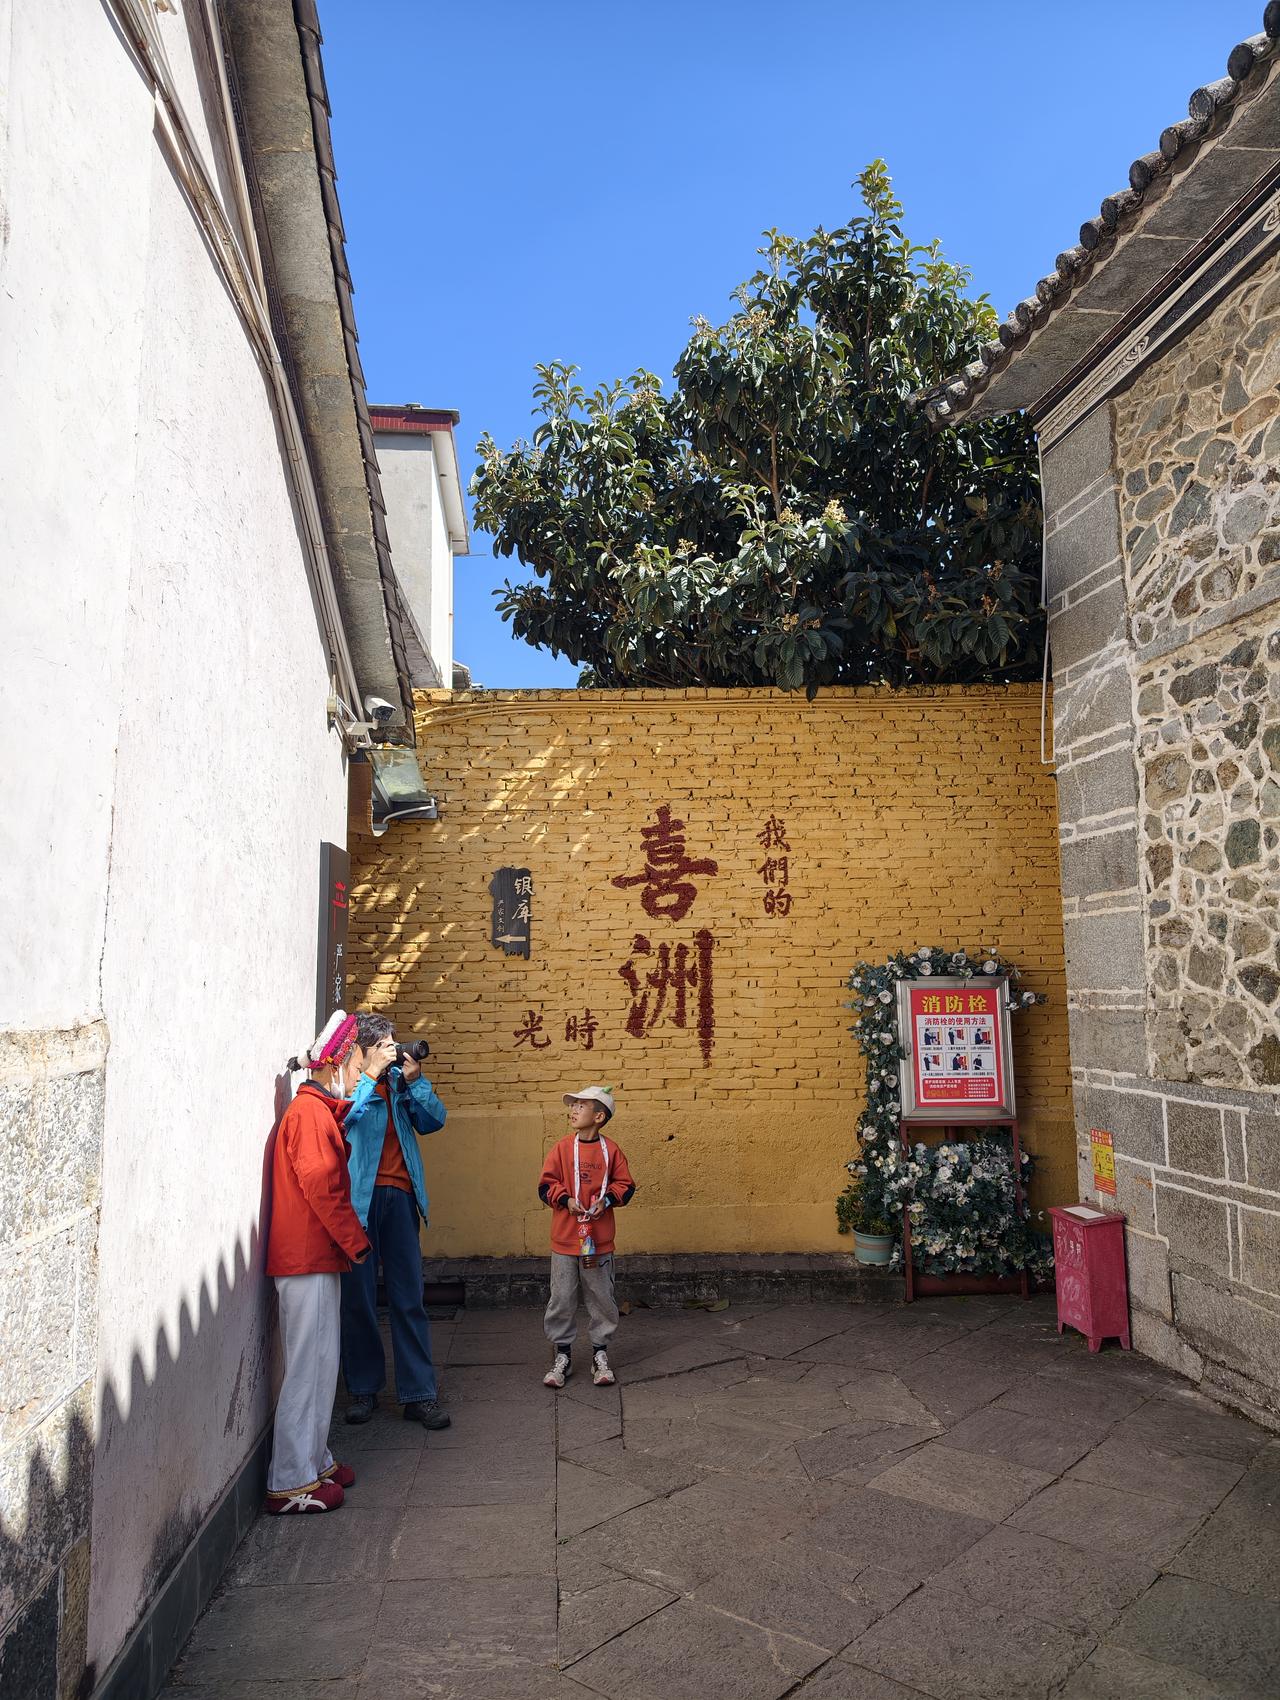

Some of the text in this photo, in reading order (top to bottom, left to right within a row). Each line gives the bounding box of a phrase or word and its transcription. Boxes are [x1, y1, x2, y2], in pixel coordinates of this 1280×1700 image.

[756, 814, 793, 917] 我們的
[511, 876, 536, 924] 银库
[611, 804, 719, 1068] 喜洲
[921, 994, 988, 1013] 消防栓
[924, 1016, 987, 1026] 消防栓的使用方法
